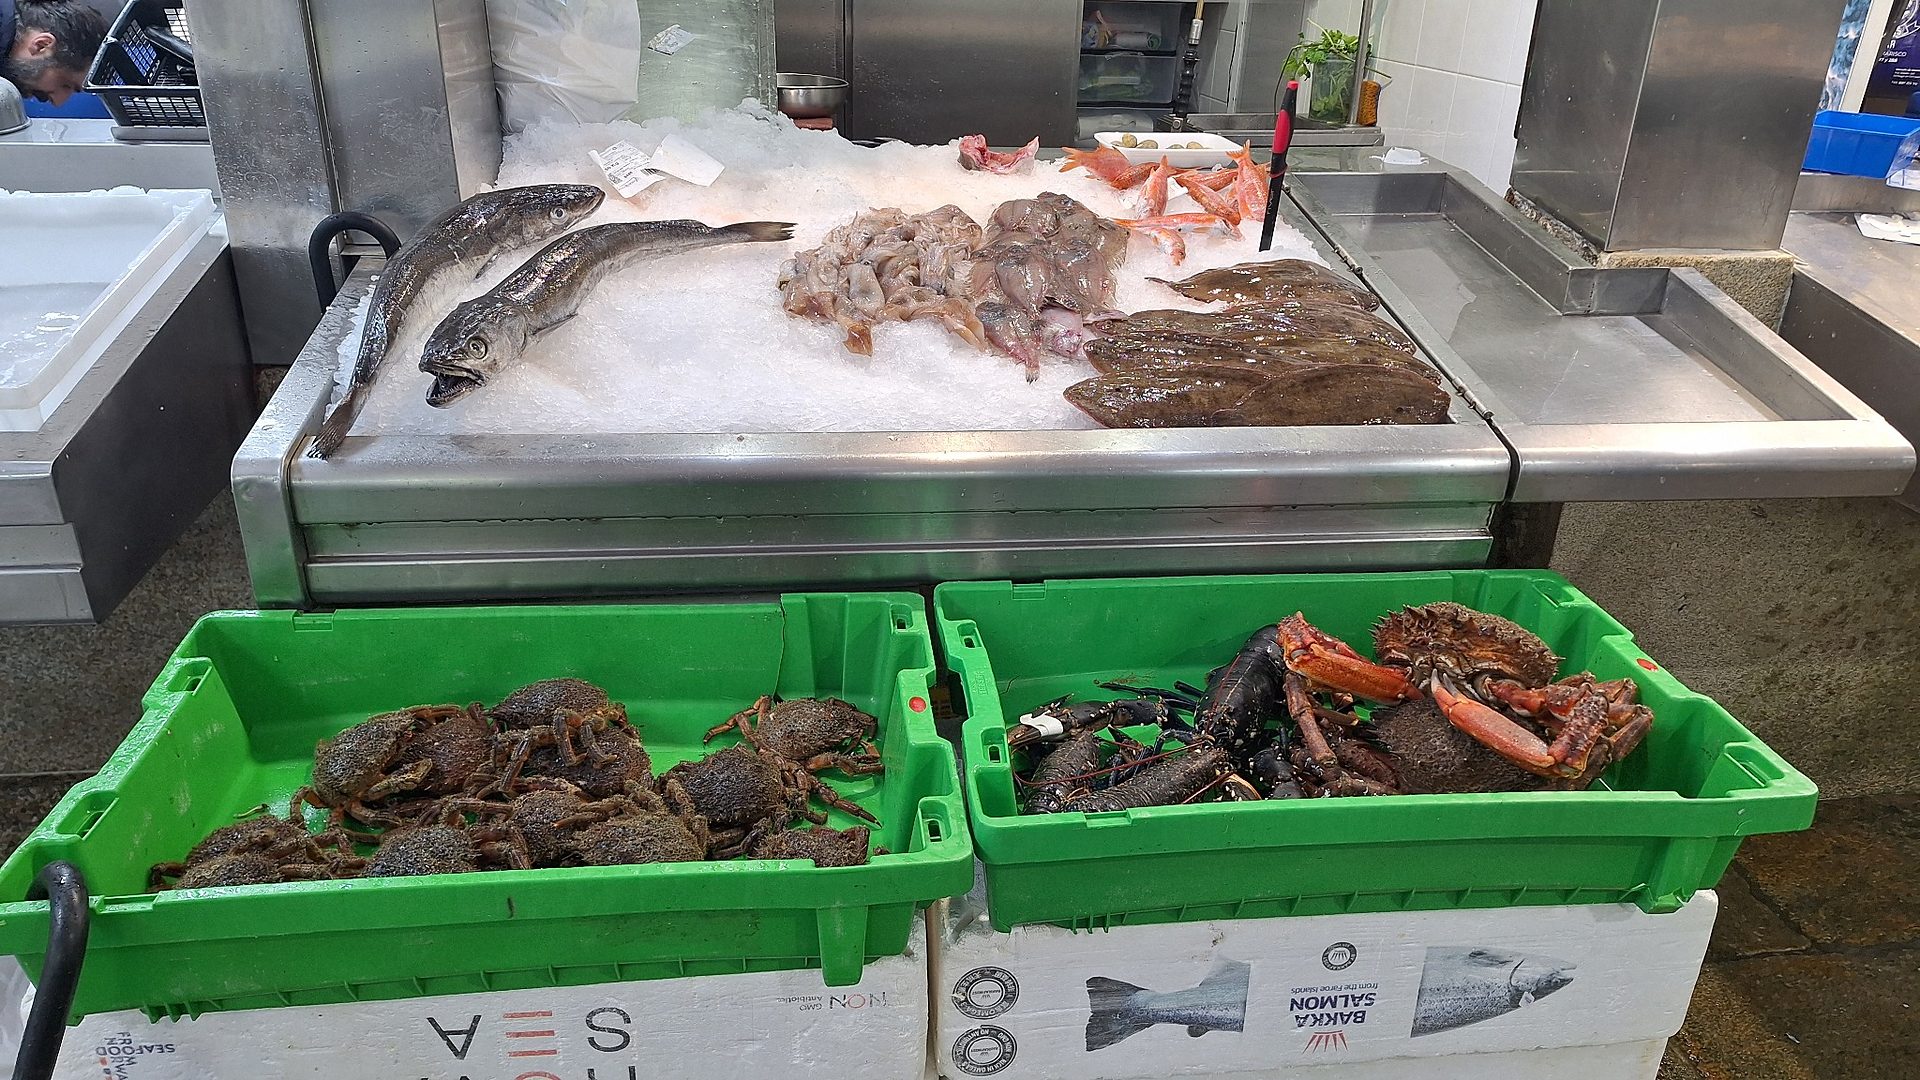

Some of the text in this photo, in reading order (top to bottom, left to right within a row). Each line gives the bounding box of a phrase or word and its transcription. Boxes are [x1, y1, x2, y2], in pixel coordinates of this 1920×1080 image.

[1290, 982, 1379, 995] from the Faroe Islands
[829, 992, 887, 1010] NON
[1290, 993, 1376, 1011] SALMON
[1295, 1010, 1366, 1027] BAKKA
[96, 1044, 175, 1055] SEAFOOD
